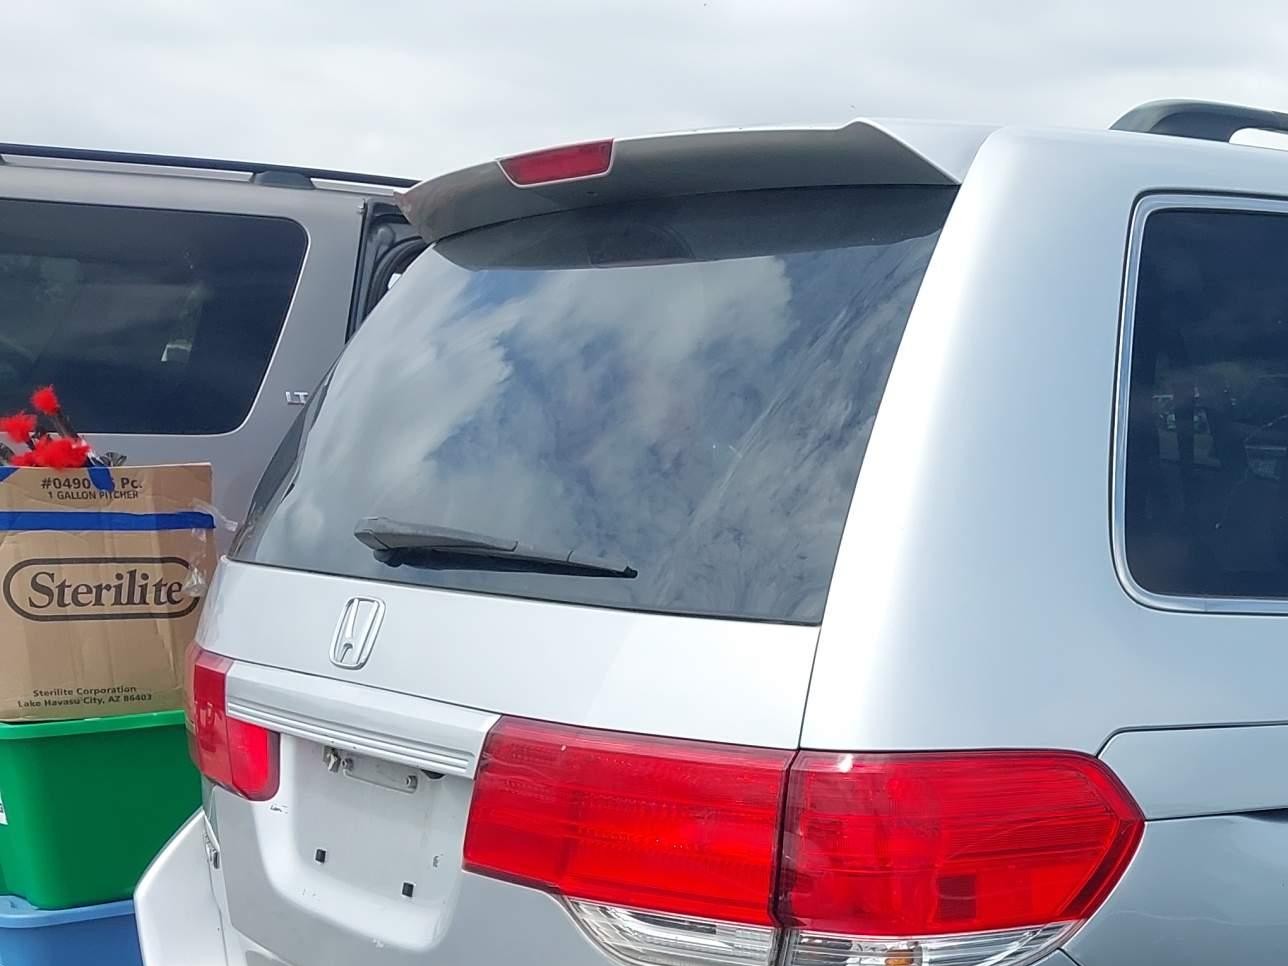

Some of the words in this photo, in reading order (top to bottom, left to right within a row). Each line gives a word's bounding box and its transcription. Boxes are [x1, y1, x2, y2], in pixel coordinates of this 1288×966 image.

[285, 391, 309, 404] LT
[48, 491, 53, 499] 1
[57, 491, 96, 500] GALLON
[28, 568, 185, 609] Sterilite
[33, 688, 74, 697] Sterilite
[76, 686, 137, 696] Corporation
[17, 700, 41, 708] Lake
[44, 698, 80, 707] Havasu
[83, 697, 105, 705] City,
[108, 695, 120, 703] AZ
